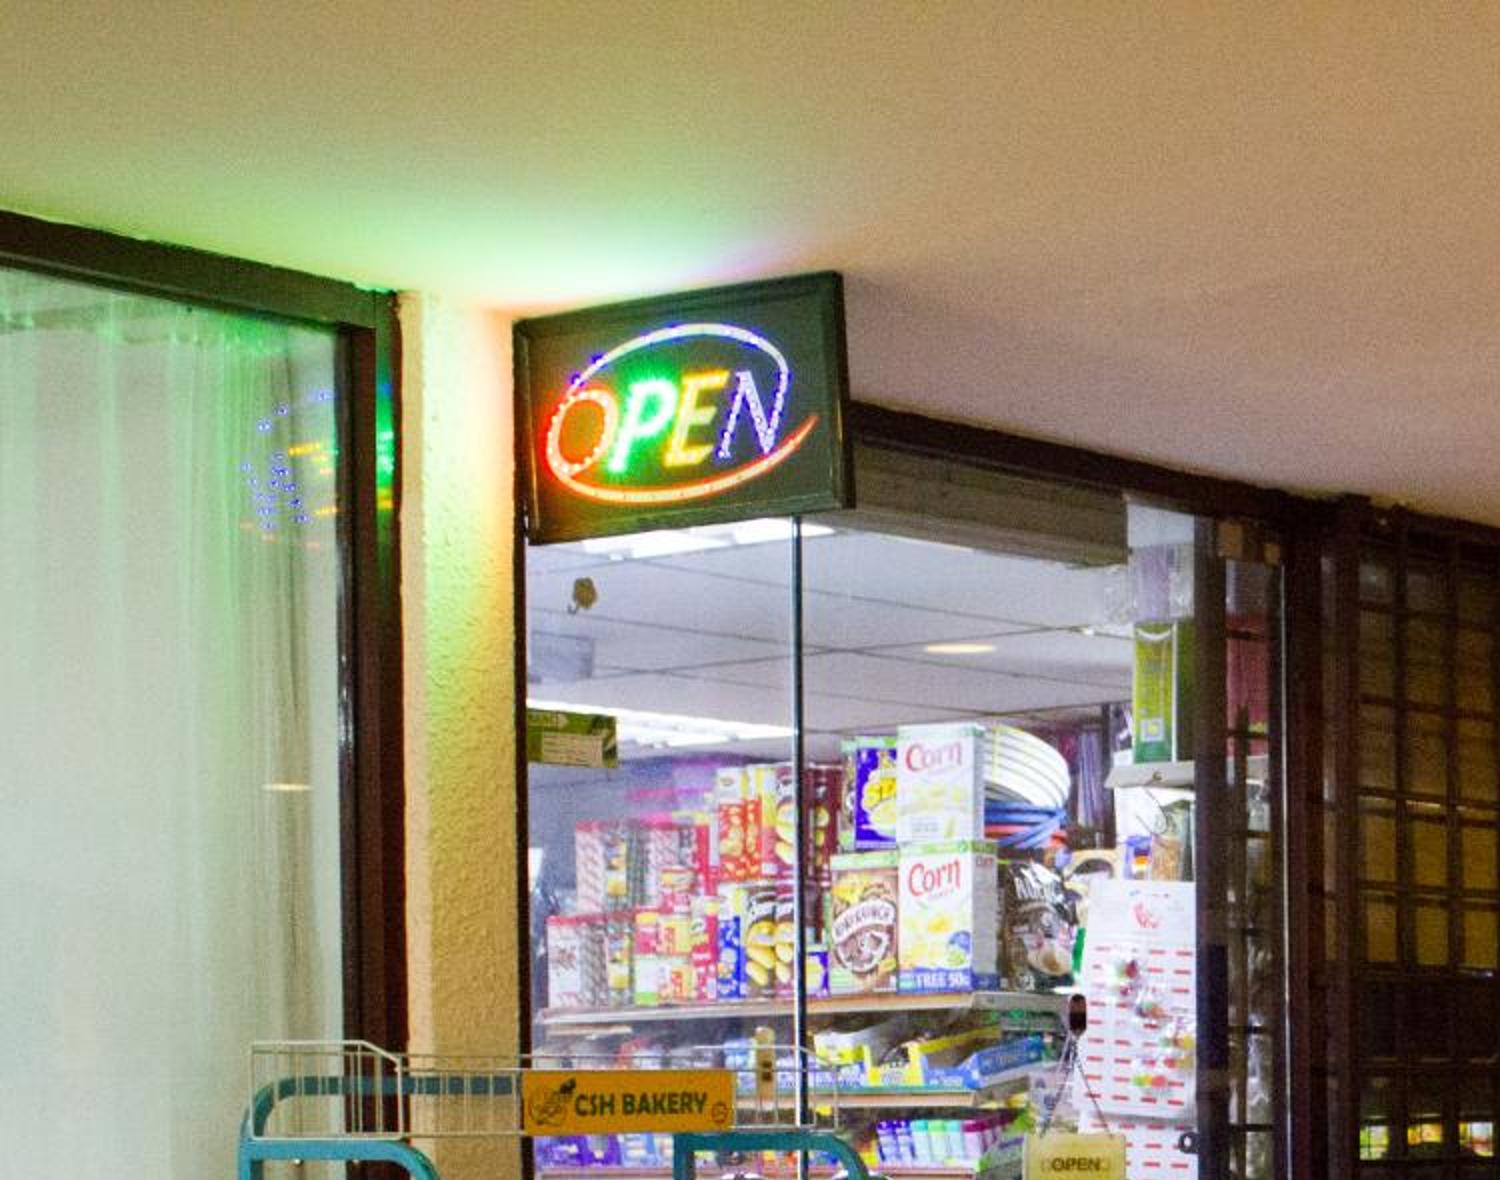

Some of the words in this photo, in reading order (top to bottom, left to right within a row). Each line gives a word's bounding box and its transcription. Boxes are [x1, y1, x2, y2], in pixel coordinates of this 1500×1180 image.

[547, 366, 791, 476] OPEN
[905, 742, 961, 772] Corn
[909, 860, 961, 897] Corn
[575, 1093, 615, 1117] CSH
[622, 1091, 708, 1117] BAKERY
[1051, 1156, 1101, 1173] OPEN
